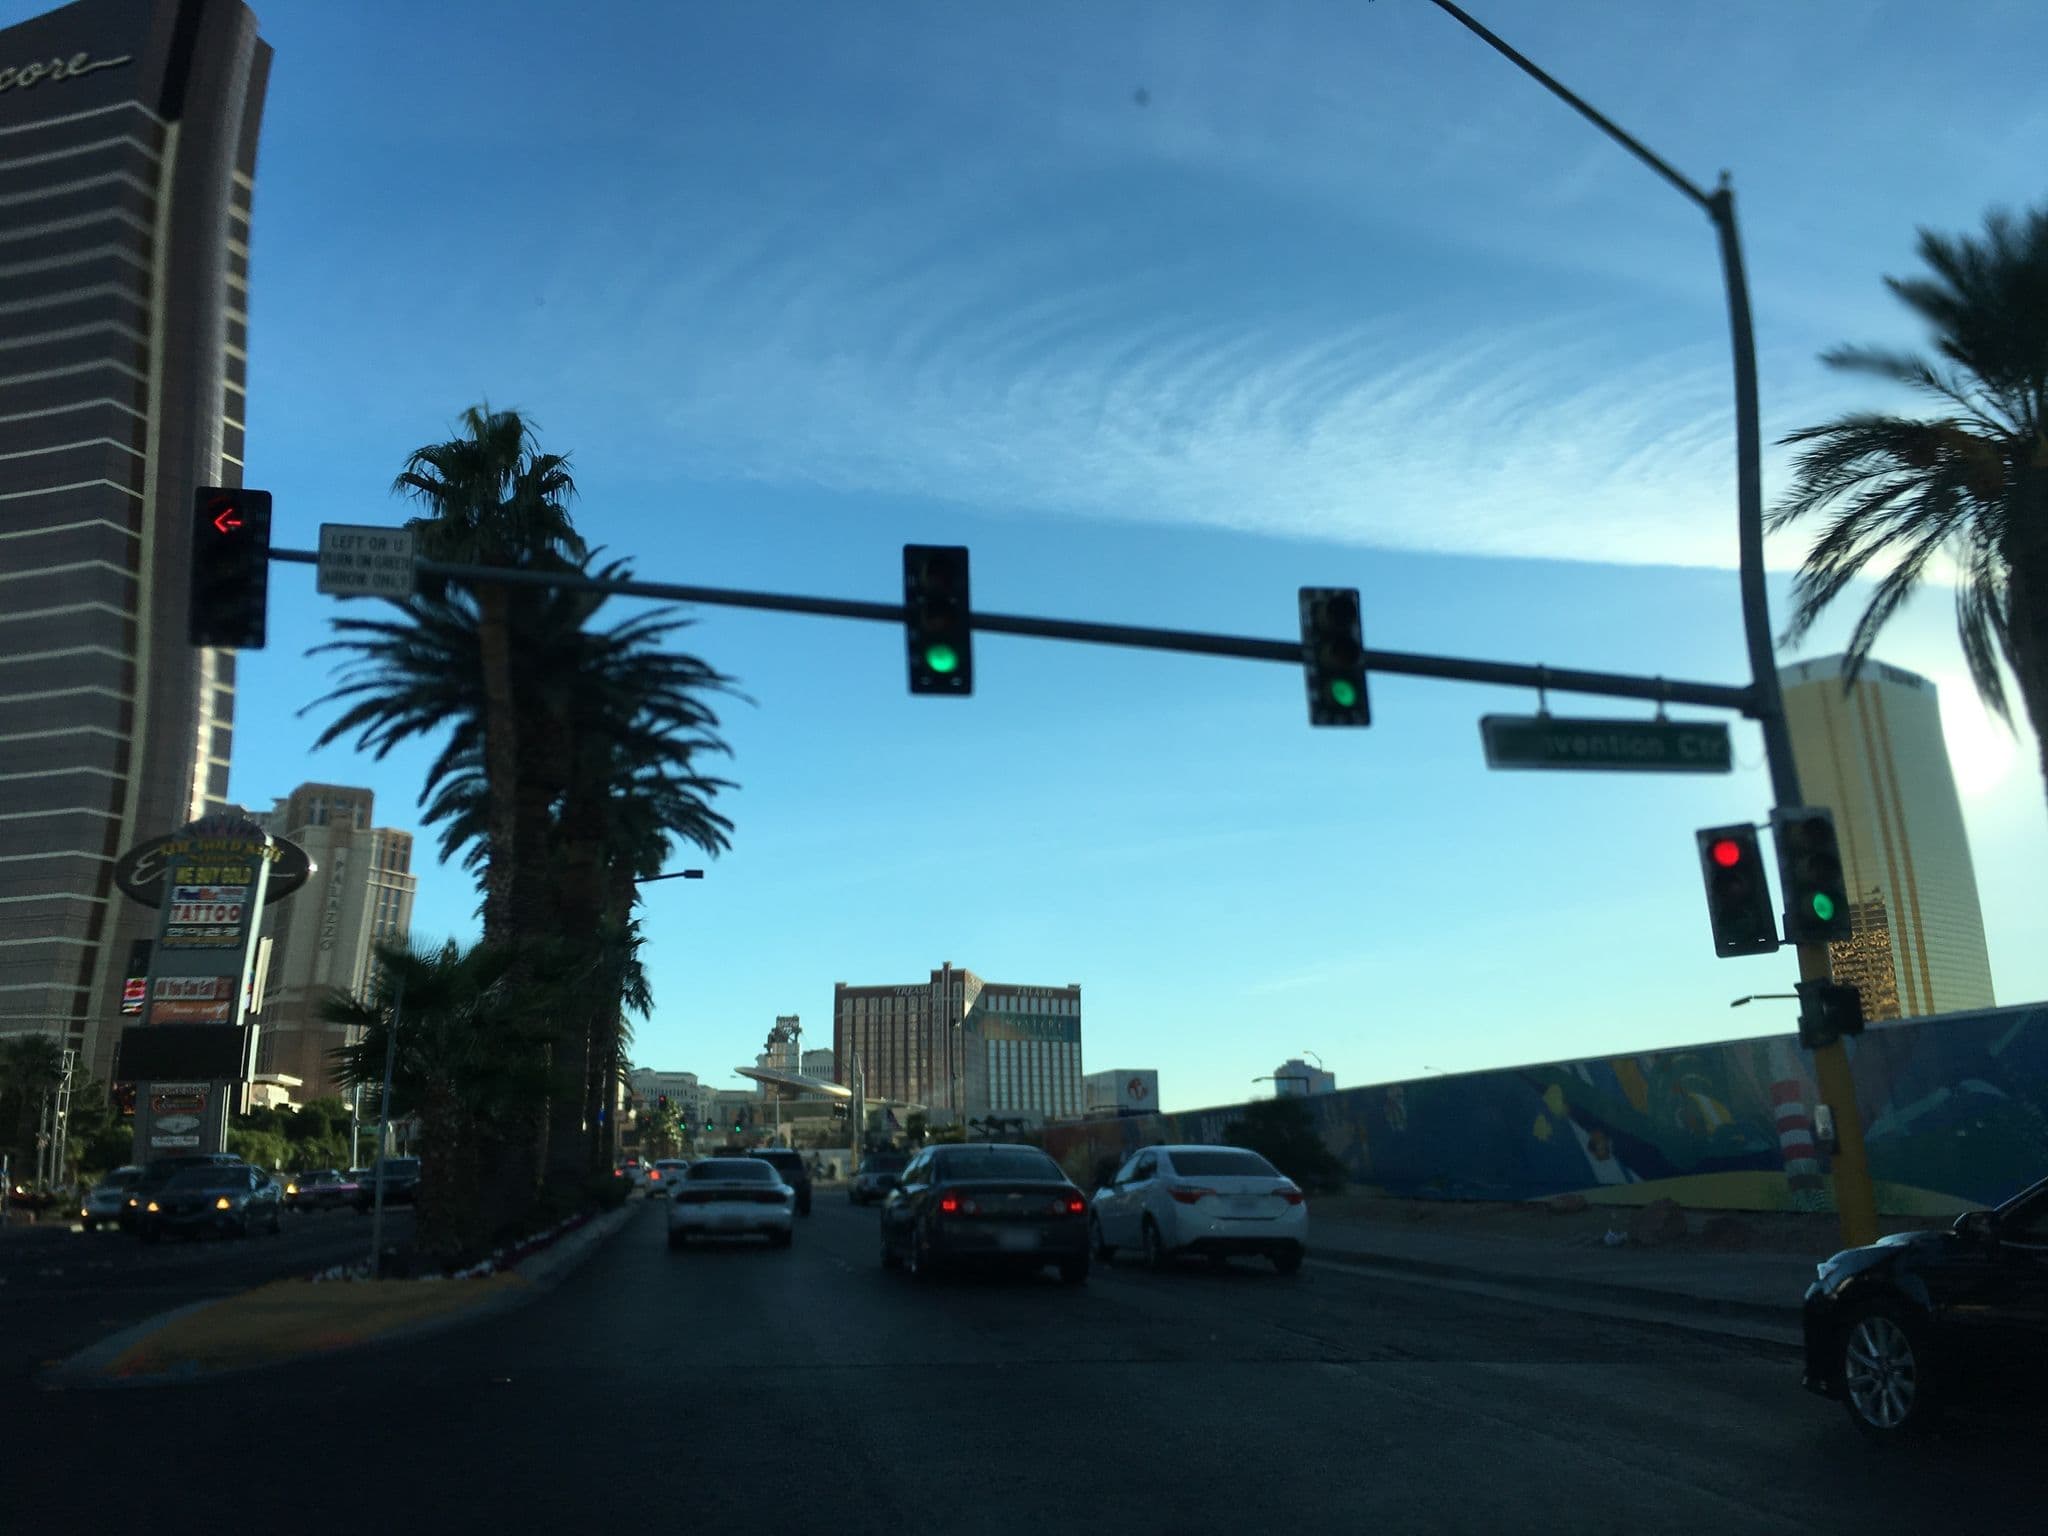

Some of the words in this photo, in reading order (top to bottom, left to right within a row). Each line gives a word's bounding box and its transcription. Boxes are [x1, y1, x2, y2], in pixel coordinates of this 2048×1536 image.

[331, 535, 364, 549] LEFT
[368, 536, 388, 551] OR
[171, 904, 241, 922] TATTOO
